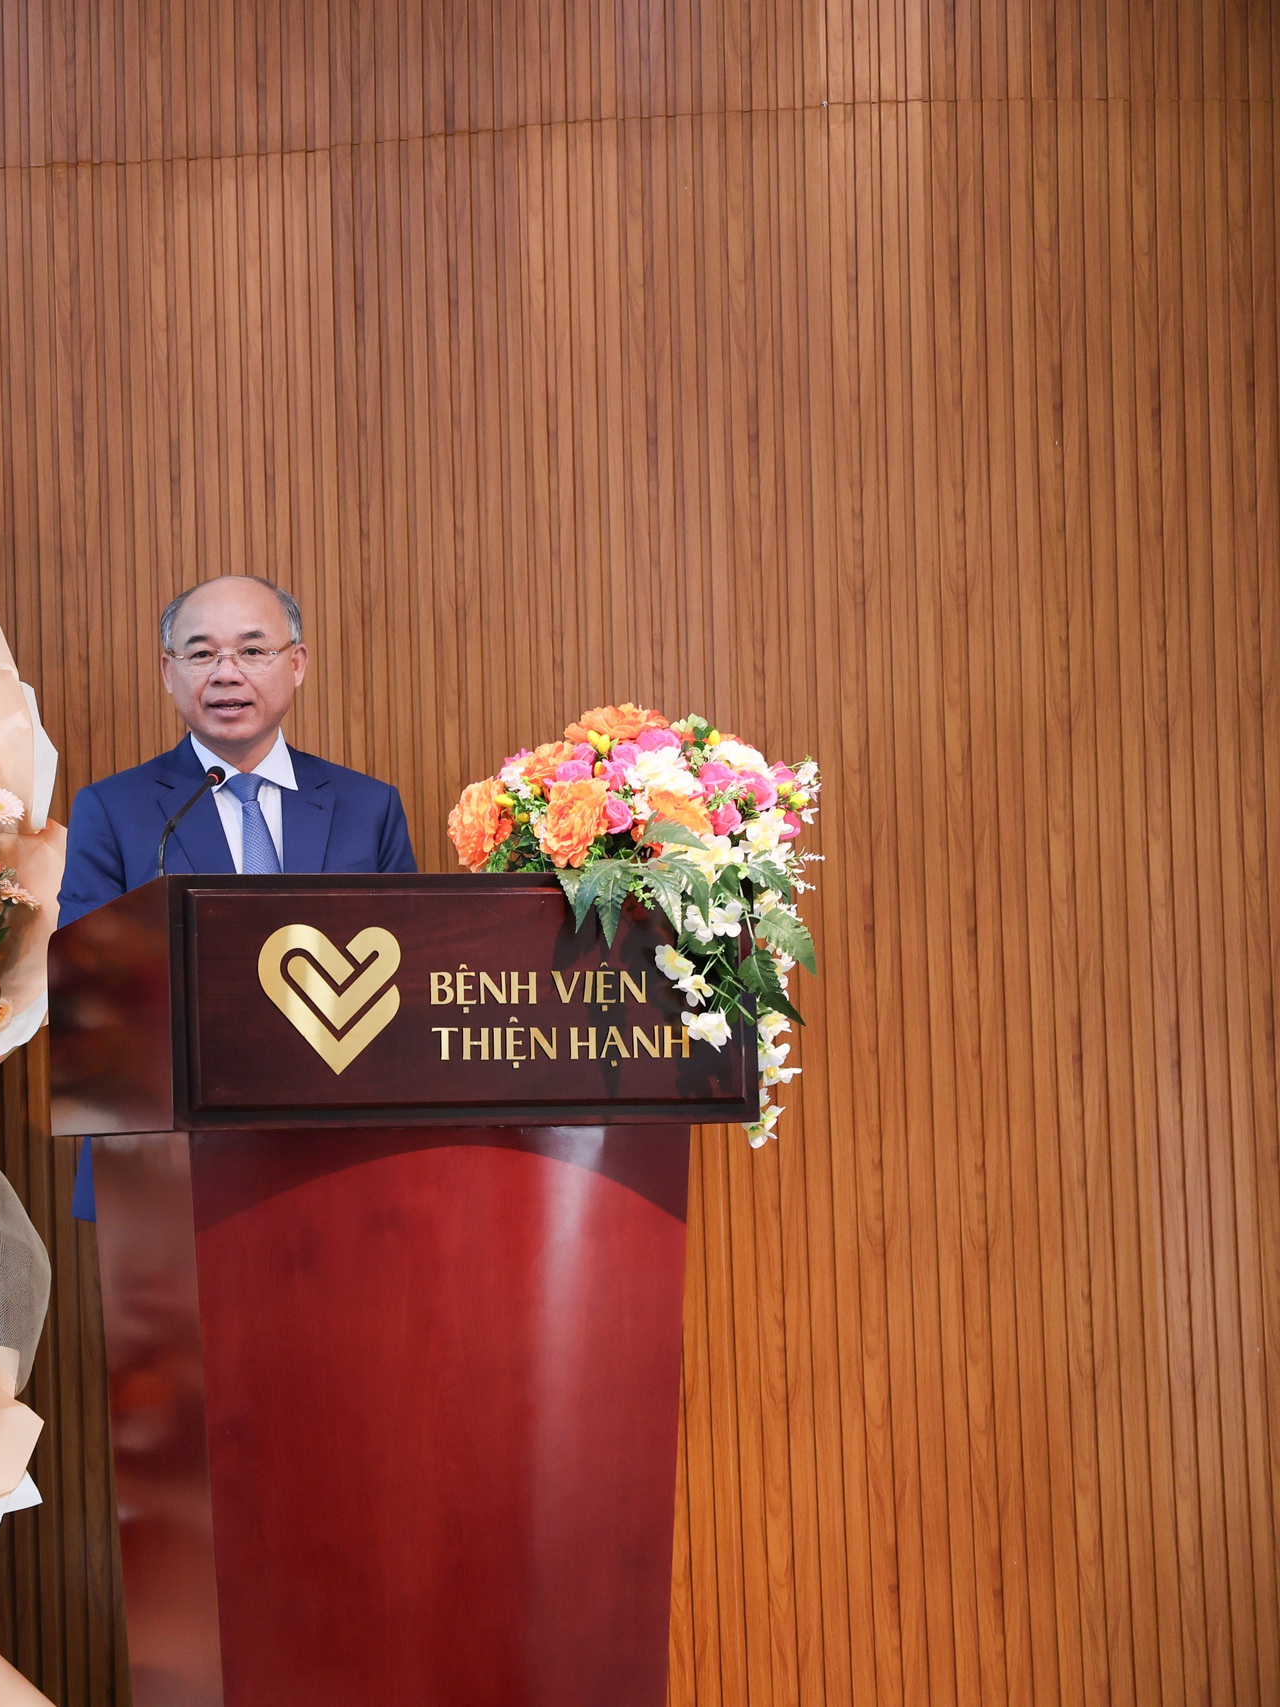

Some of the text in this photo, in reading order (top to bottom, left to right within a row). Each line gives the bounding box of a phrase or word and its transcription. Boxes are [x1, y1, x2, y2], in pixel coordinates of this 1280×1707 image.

[430, 961, 647, 1014] BỆNH VIỆN
[431, 1016, 691, 1069] THIỆN HẠNH
